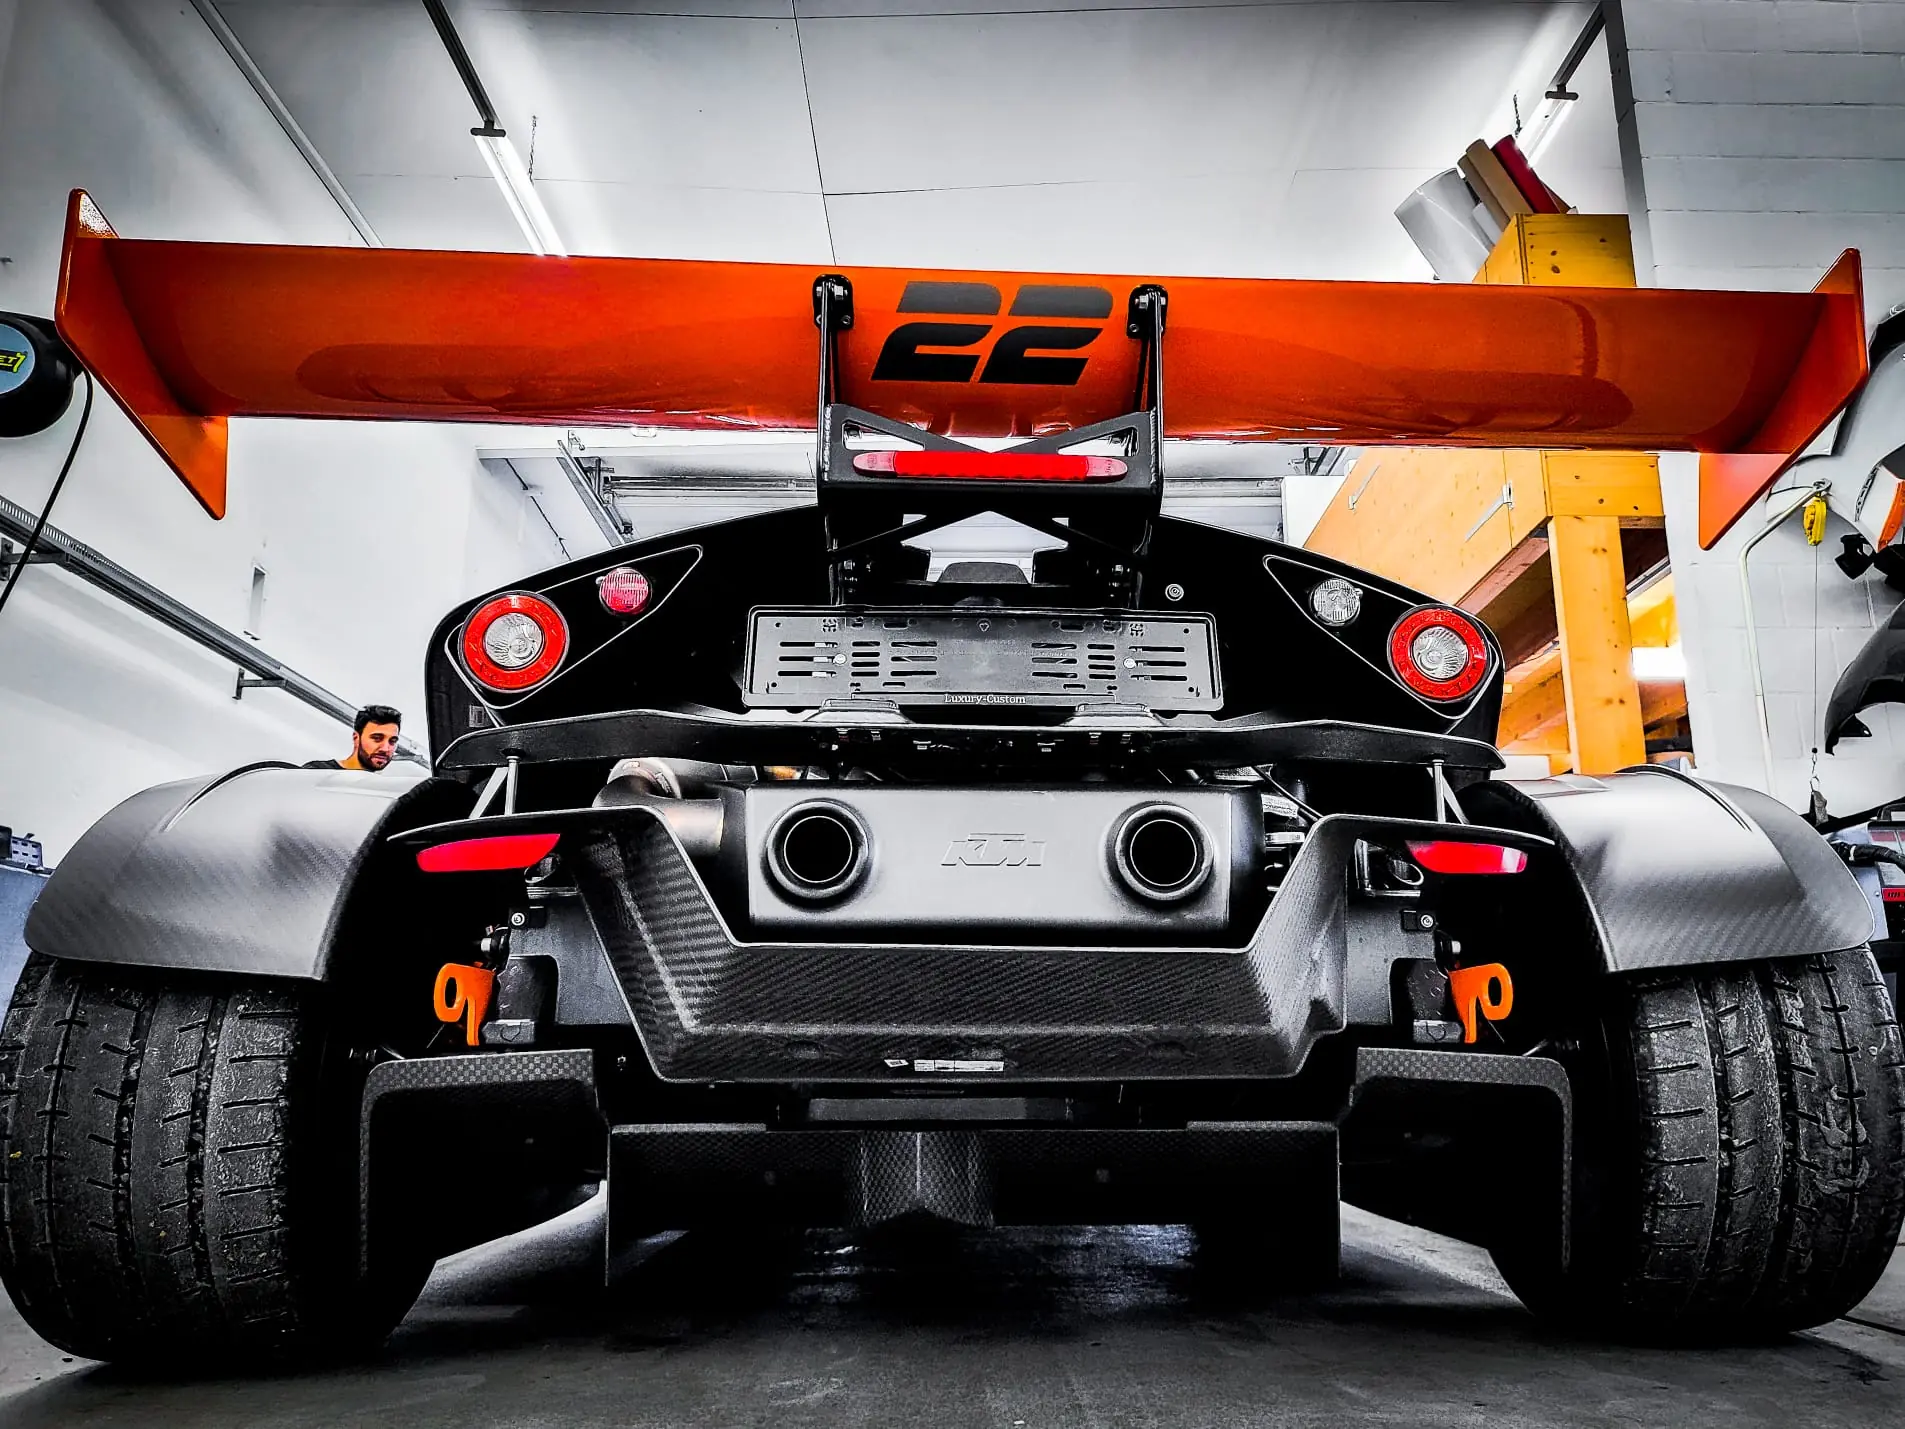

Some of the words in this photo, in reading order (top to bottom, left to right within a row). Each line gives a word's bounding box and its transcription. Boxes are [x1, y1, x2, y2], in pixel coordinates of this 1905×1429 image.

[870, 281, 1113, 386] 22
[944, 694, 1026, 705] Luxury-Custom
[940, 832, 1046, 867] KTM
